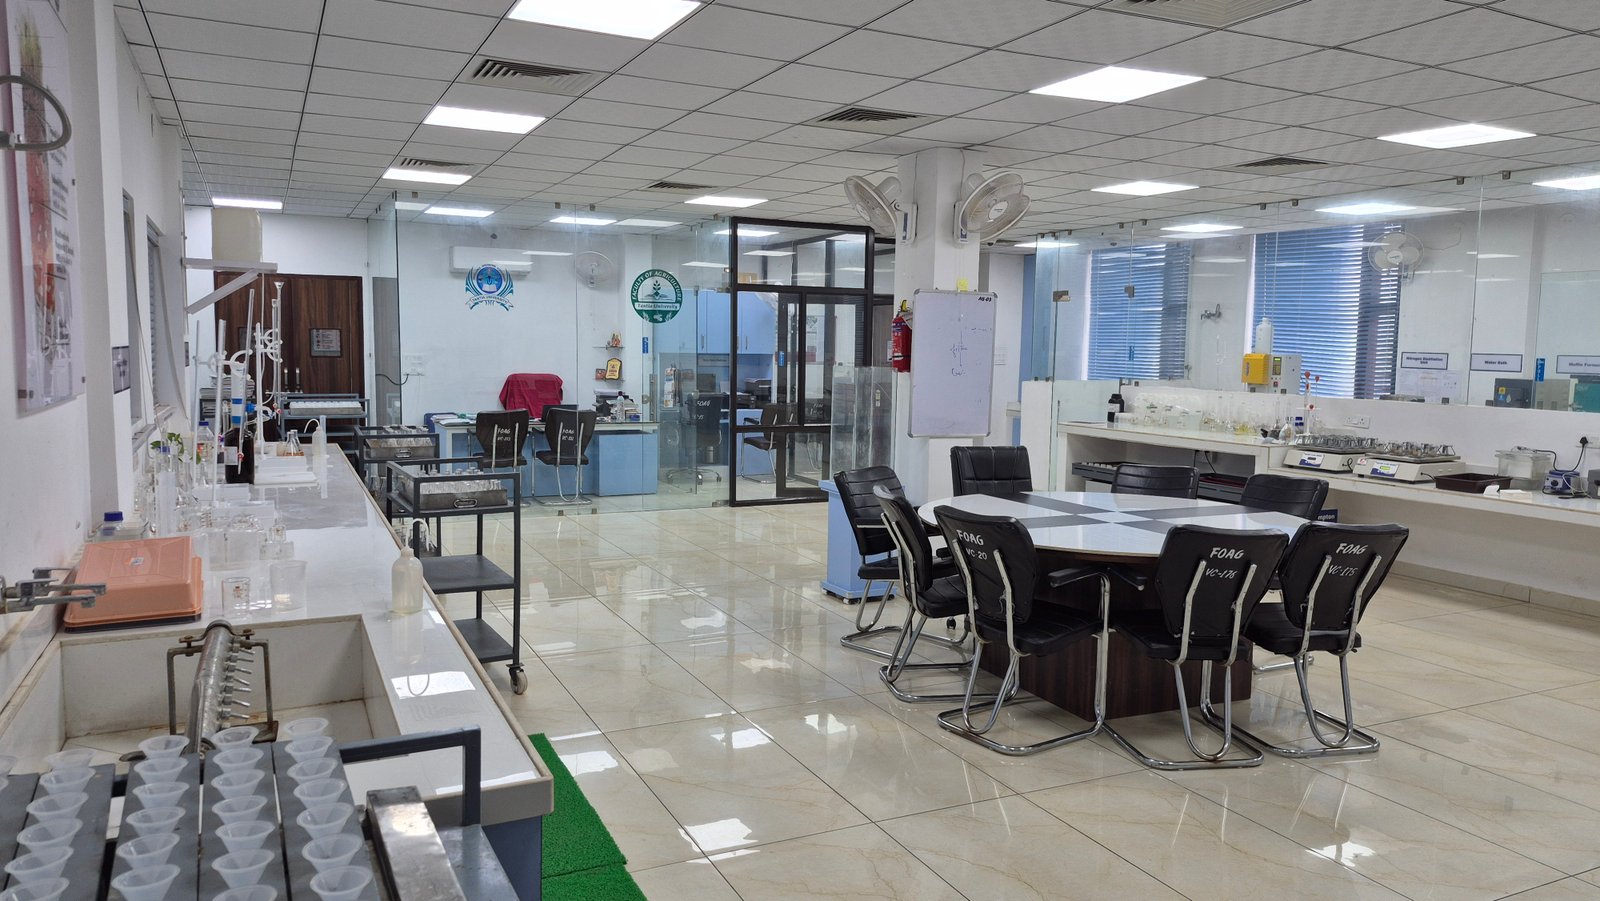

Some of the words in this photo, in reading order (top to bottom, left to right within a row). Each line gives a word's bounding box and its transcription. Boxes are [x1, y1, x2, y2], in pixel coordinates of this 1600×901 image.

[632, 276, 645, 300] FACULTY
[654, 271, 682, 300] AGRICULTURE
[956, 529, 984, 546] FOAG
[965, 547, 988, 560] VC-20
[1210, 547, 1244, 559] FOAG
[1336, 543, 1369, 555] FOAG
[1205, 568, 1238, 579] VC-176
[1328, 564, 1358, 577] VC-175
